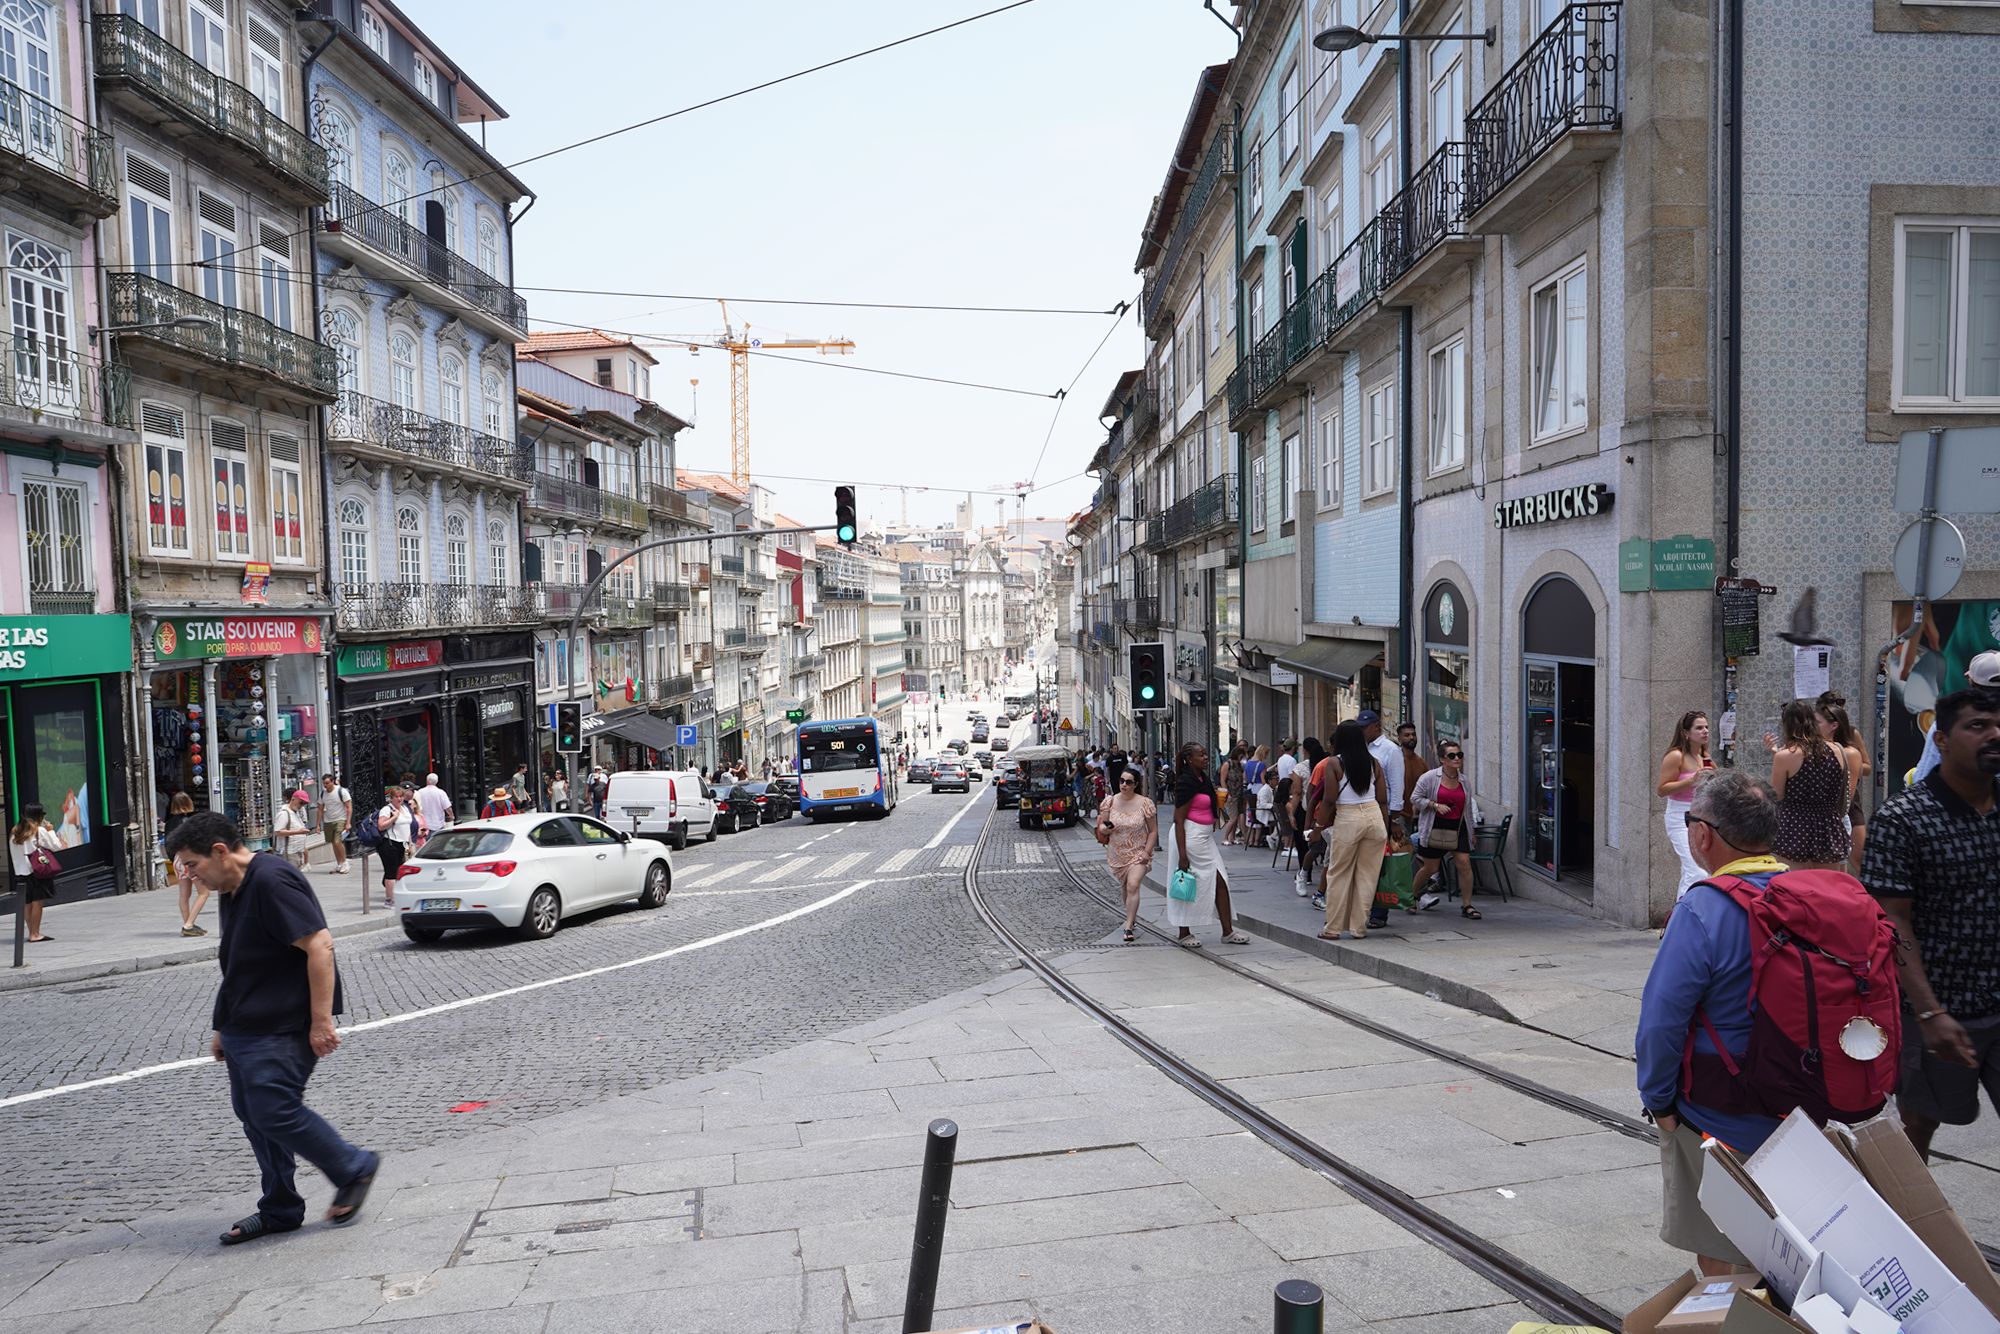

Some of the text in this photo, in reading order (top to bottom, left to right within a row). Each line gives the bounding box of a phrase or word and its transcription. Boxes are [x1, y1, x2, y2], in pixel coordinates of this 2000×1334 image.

[1494, 484, 1599, 529] STARBUCKS
[1662, 552, 1706, 562] ARQUITECTO
[1654, 562, 1713, 572] NICOLAU NASONI
[186, 621, 296, 641] STAR SOUVENIR
[206, 642, 282, 654] PORTO PARA O MUNDO
[395, 646, 430, 664] PORTUGAL
[466, 675, 488, 688] BAZAR
[490, 673, 516, 684] CENTRAL
[375, 687, 414, 700] OFFICIAL STORE
[488, 699, 513, 717] sportino
[681, 728, 692, 744] P
[831, 741, 844, 750] 501
[1870, 1282, 1891, 1301] FE
